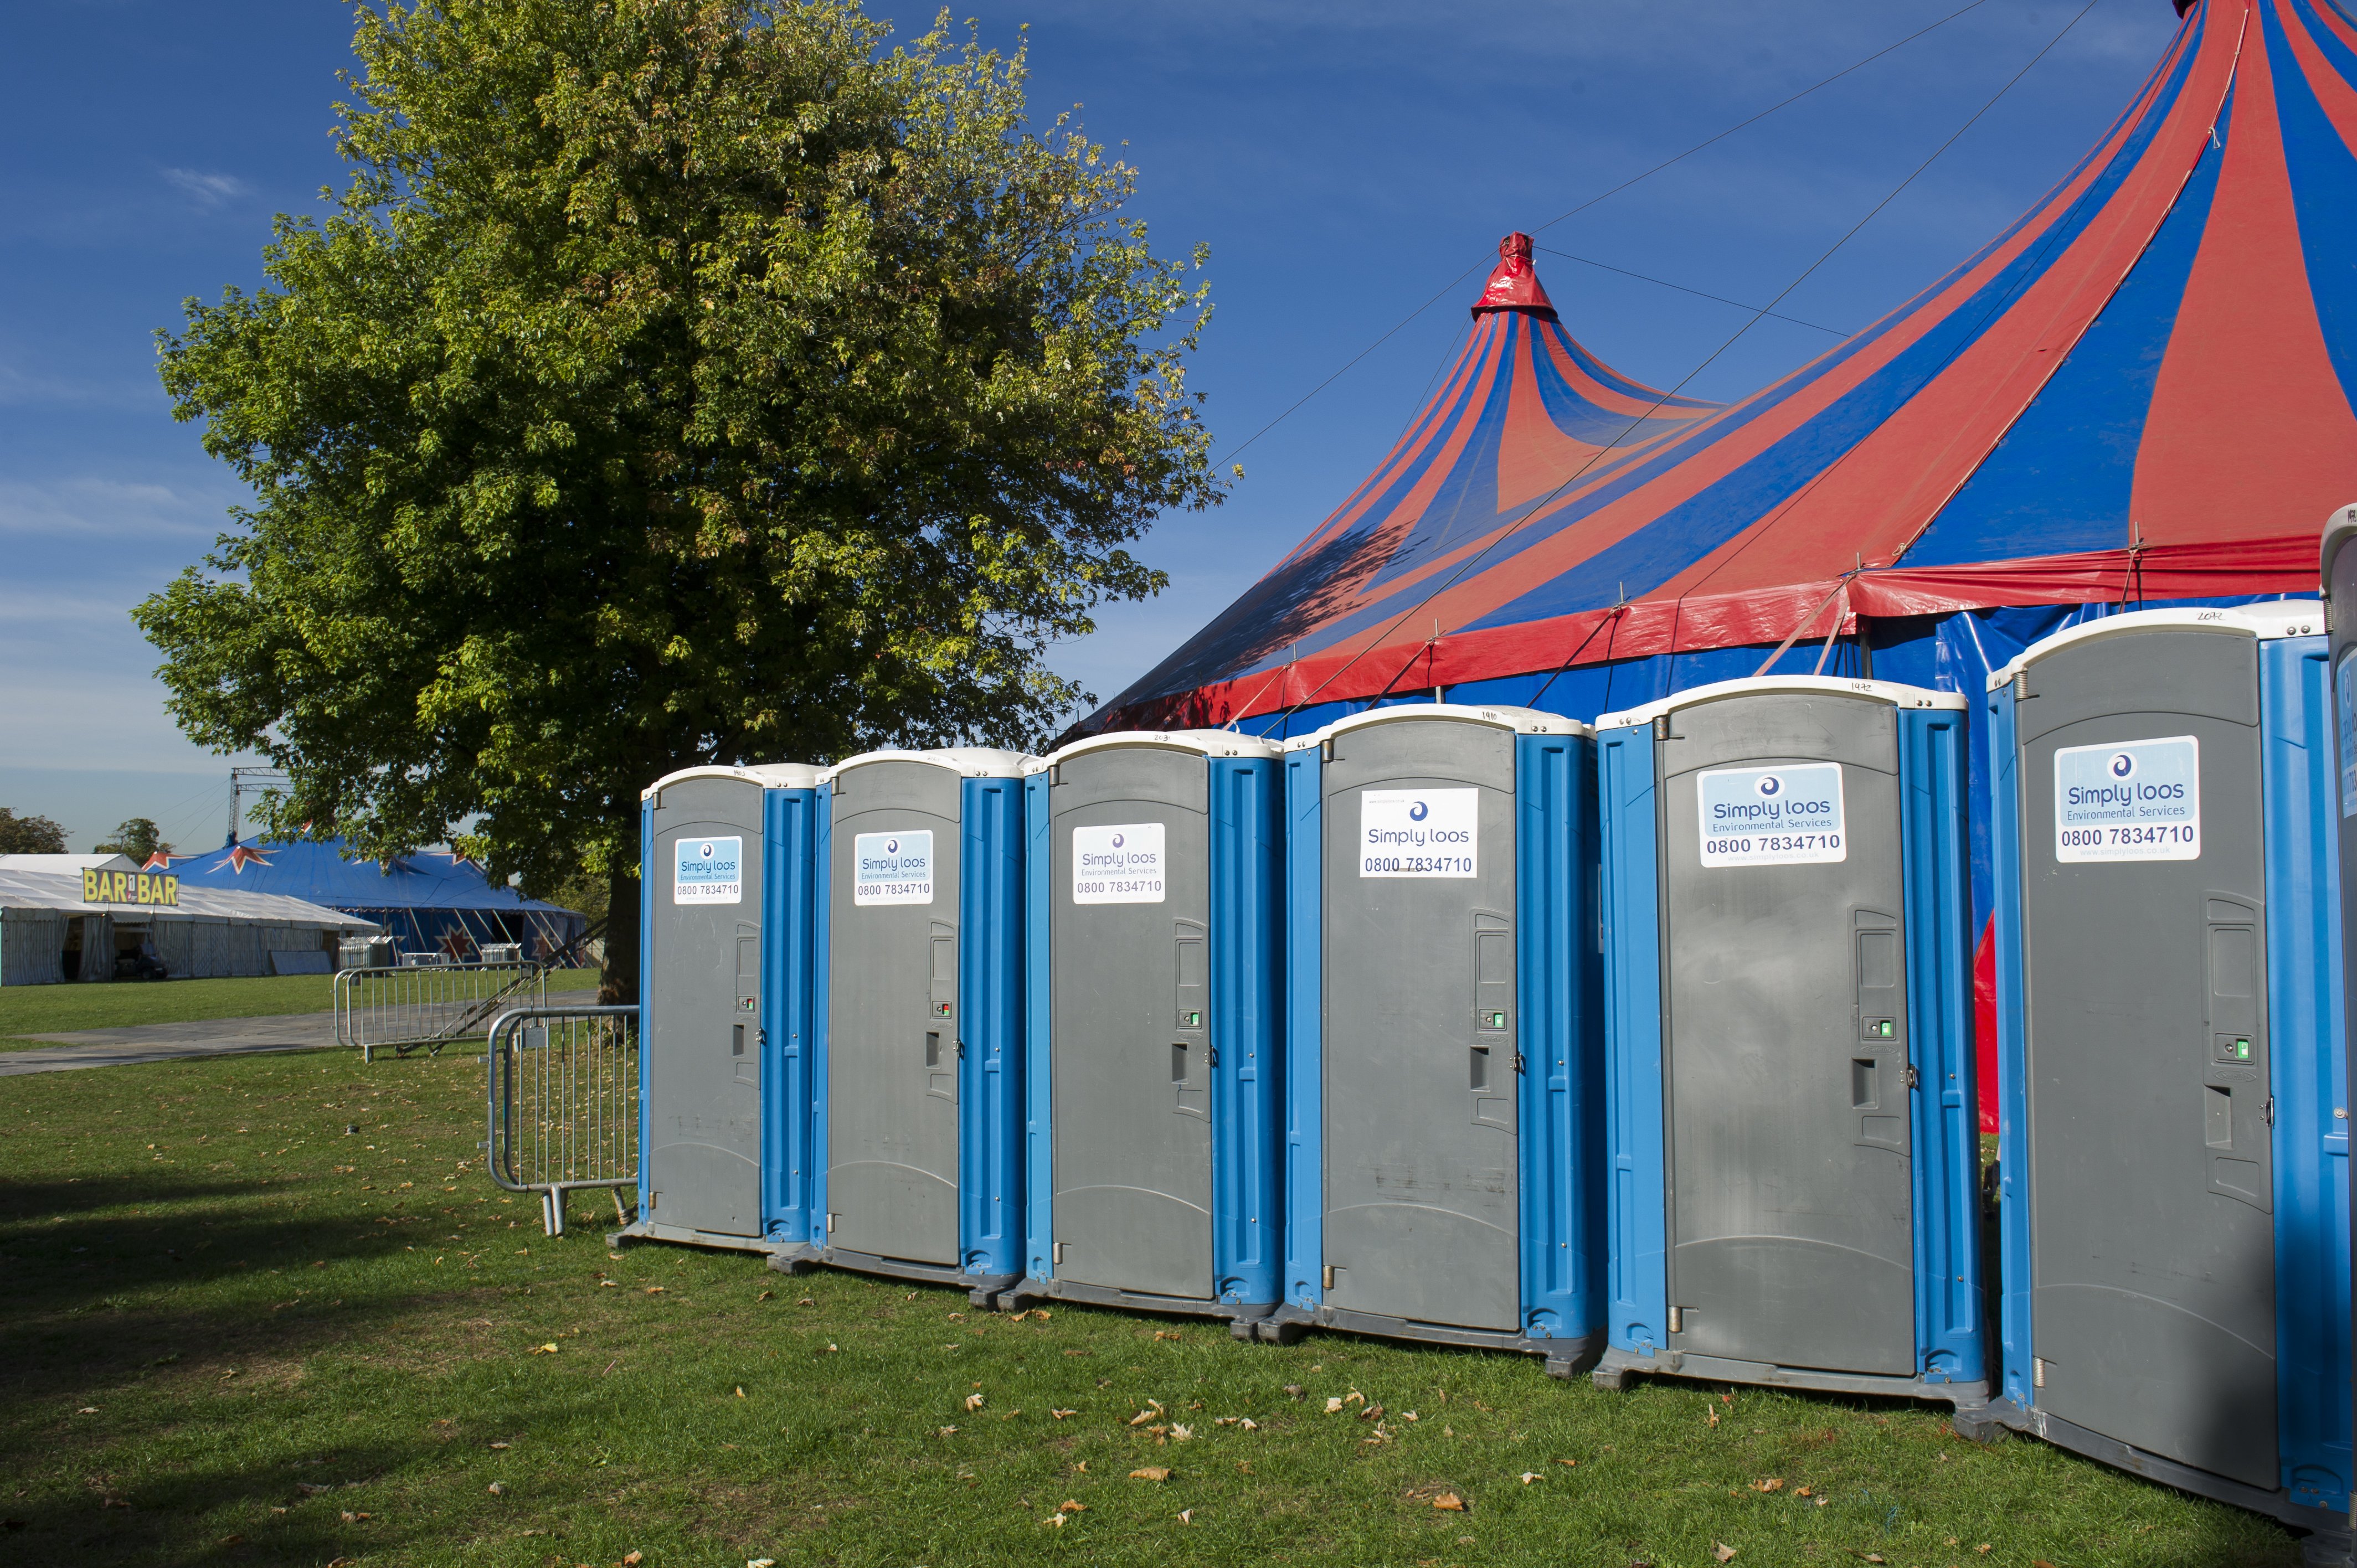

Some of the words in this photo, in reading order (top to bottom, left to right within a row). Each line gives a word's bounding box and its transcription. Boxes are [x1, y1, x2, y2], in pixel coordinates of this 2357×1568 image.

[1852, 683, 1872, 691] 1972
[1483, 711, 1497, 720] 1910
[2069, 785, 2131, 807] Simply
[2138, 783, 2184, 800] loos
[1714, 802, 1779, 820] Simply
[1785, 800, 1830, 815] loos
[2068, 808, 2134, 820] Environmental
[2140, 806, 2185, 817] Services
[1713, 819, 1784, 832] Environmental
[1788, 818, 1831, 828] Services
[1368, 829, 1425, 847] Simply
[1430, 829, 1469, 842] loos
[2062, 830, 2102, 846] 0800
[2109, 826, 2193, 844] 7834710
[1707, 839, 1751, 853] 0800
[1759, 834, 1840, 851] 7834710
[2080, 846, 2170, 857] www.simplyloos.co.uk
[681, 860, 712, 873] Simply
[714, 860, 735, 870] loos
[862, 857, 898, 871] Simply
[900, 857, 925, 868] loos
[1083, 853, 1124, 868] Simply
[1127, 852, 1156, 864] loos
[1365, 858, 1399, 871] 0800
[1406, 858, 1471, 872] 7834710
[861, 871, 899, 879] Environmental
[1082, 867, 1125, 876] Environmental
[84, 870, 127, 902] BAR
[138, 874, 177, 905] BAR
[677, 886, 697, 895] 0800
[701, 885, 738, 895] 7834710
[858, 885, 881, 895] 0800
[885, 884, 930, 895] 7834710
[1077, 883, 1105, 893] 0800
[1109, 881, 1161, 893] 7834710
